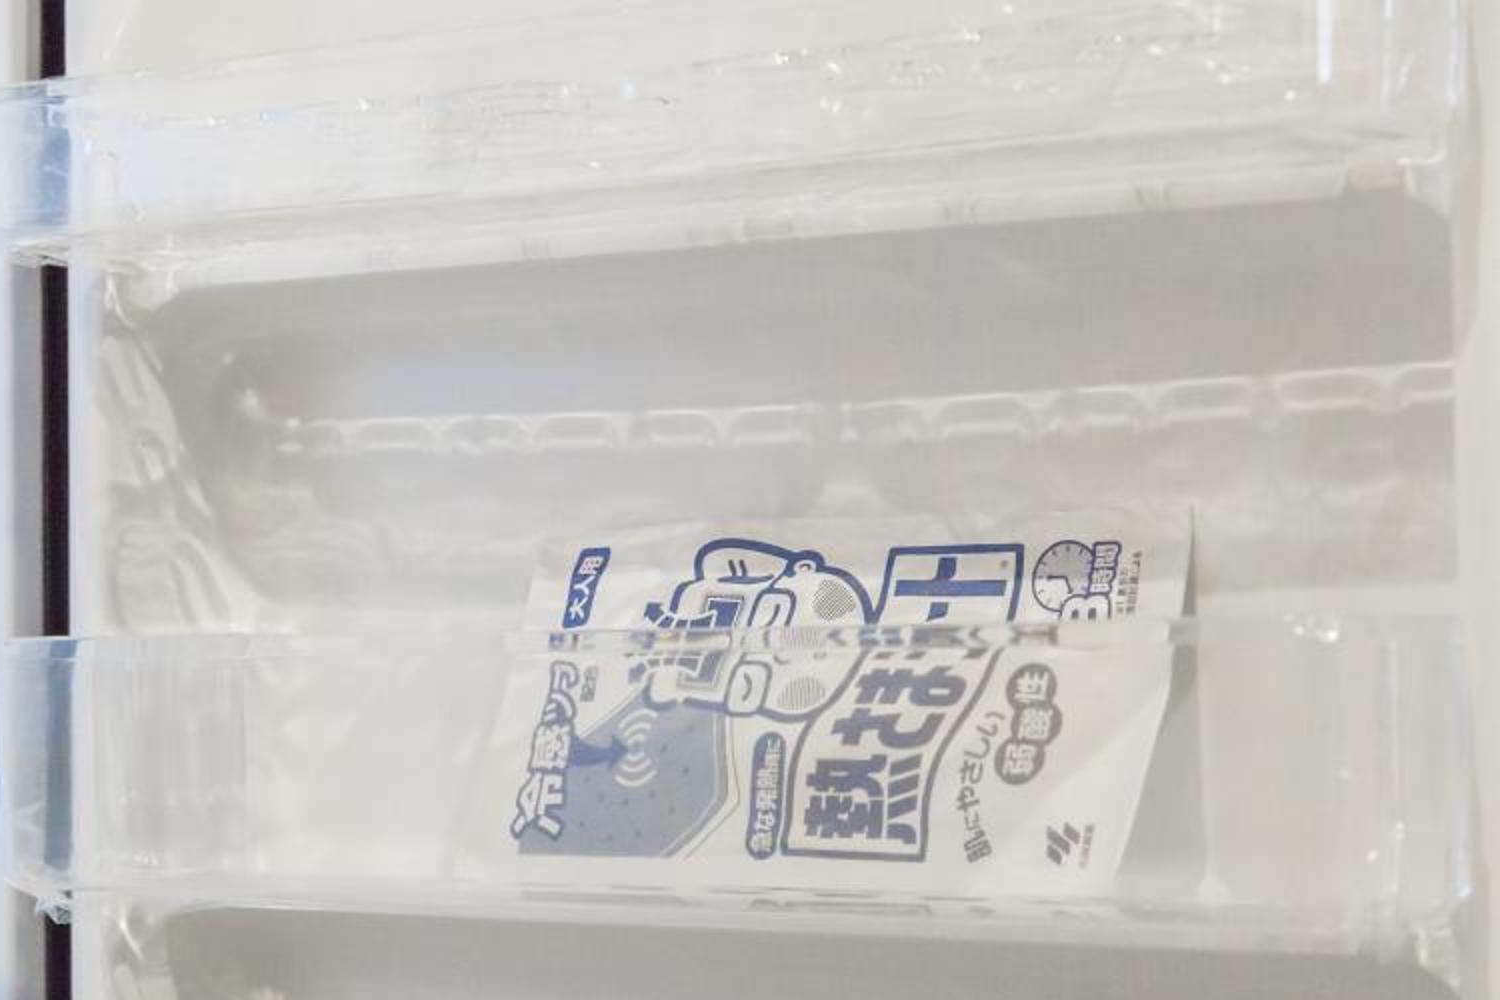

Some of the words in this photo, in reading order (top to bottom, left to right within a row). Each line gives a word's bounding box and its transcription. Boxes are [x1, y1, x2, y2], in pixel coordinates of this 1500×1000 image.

[568, 555, 605, 621] 大人用
[1002, 671, 1053, 777] 弱酸性
[954, 711, 1007, 864] 肌にやさしい
